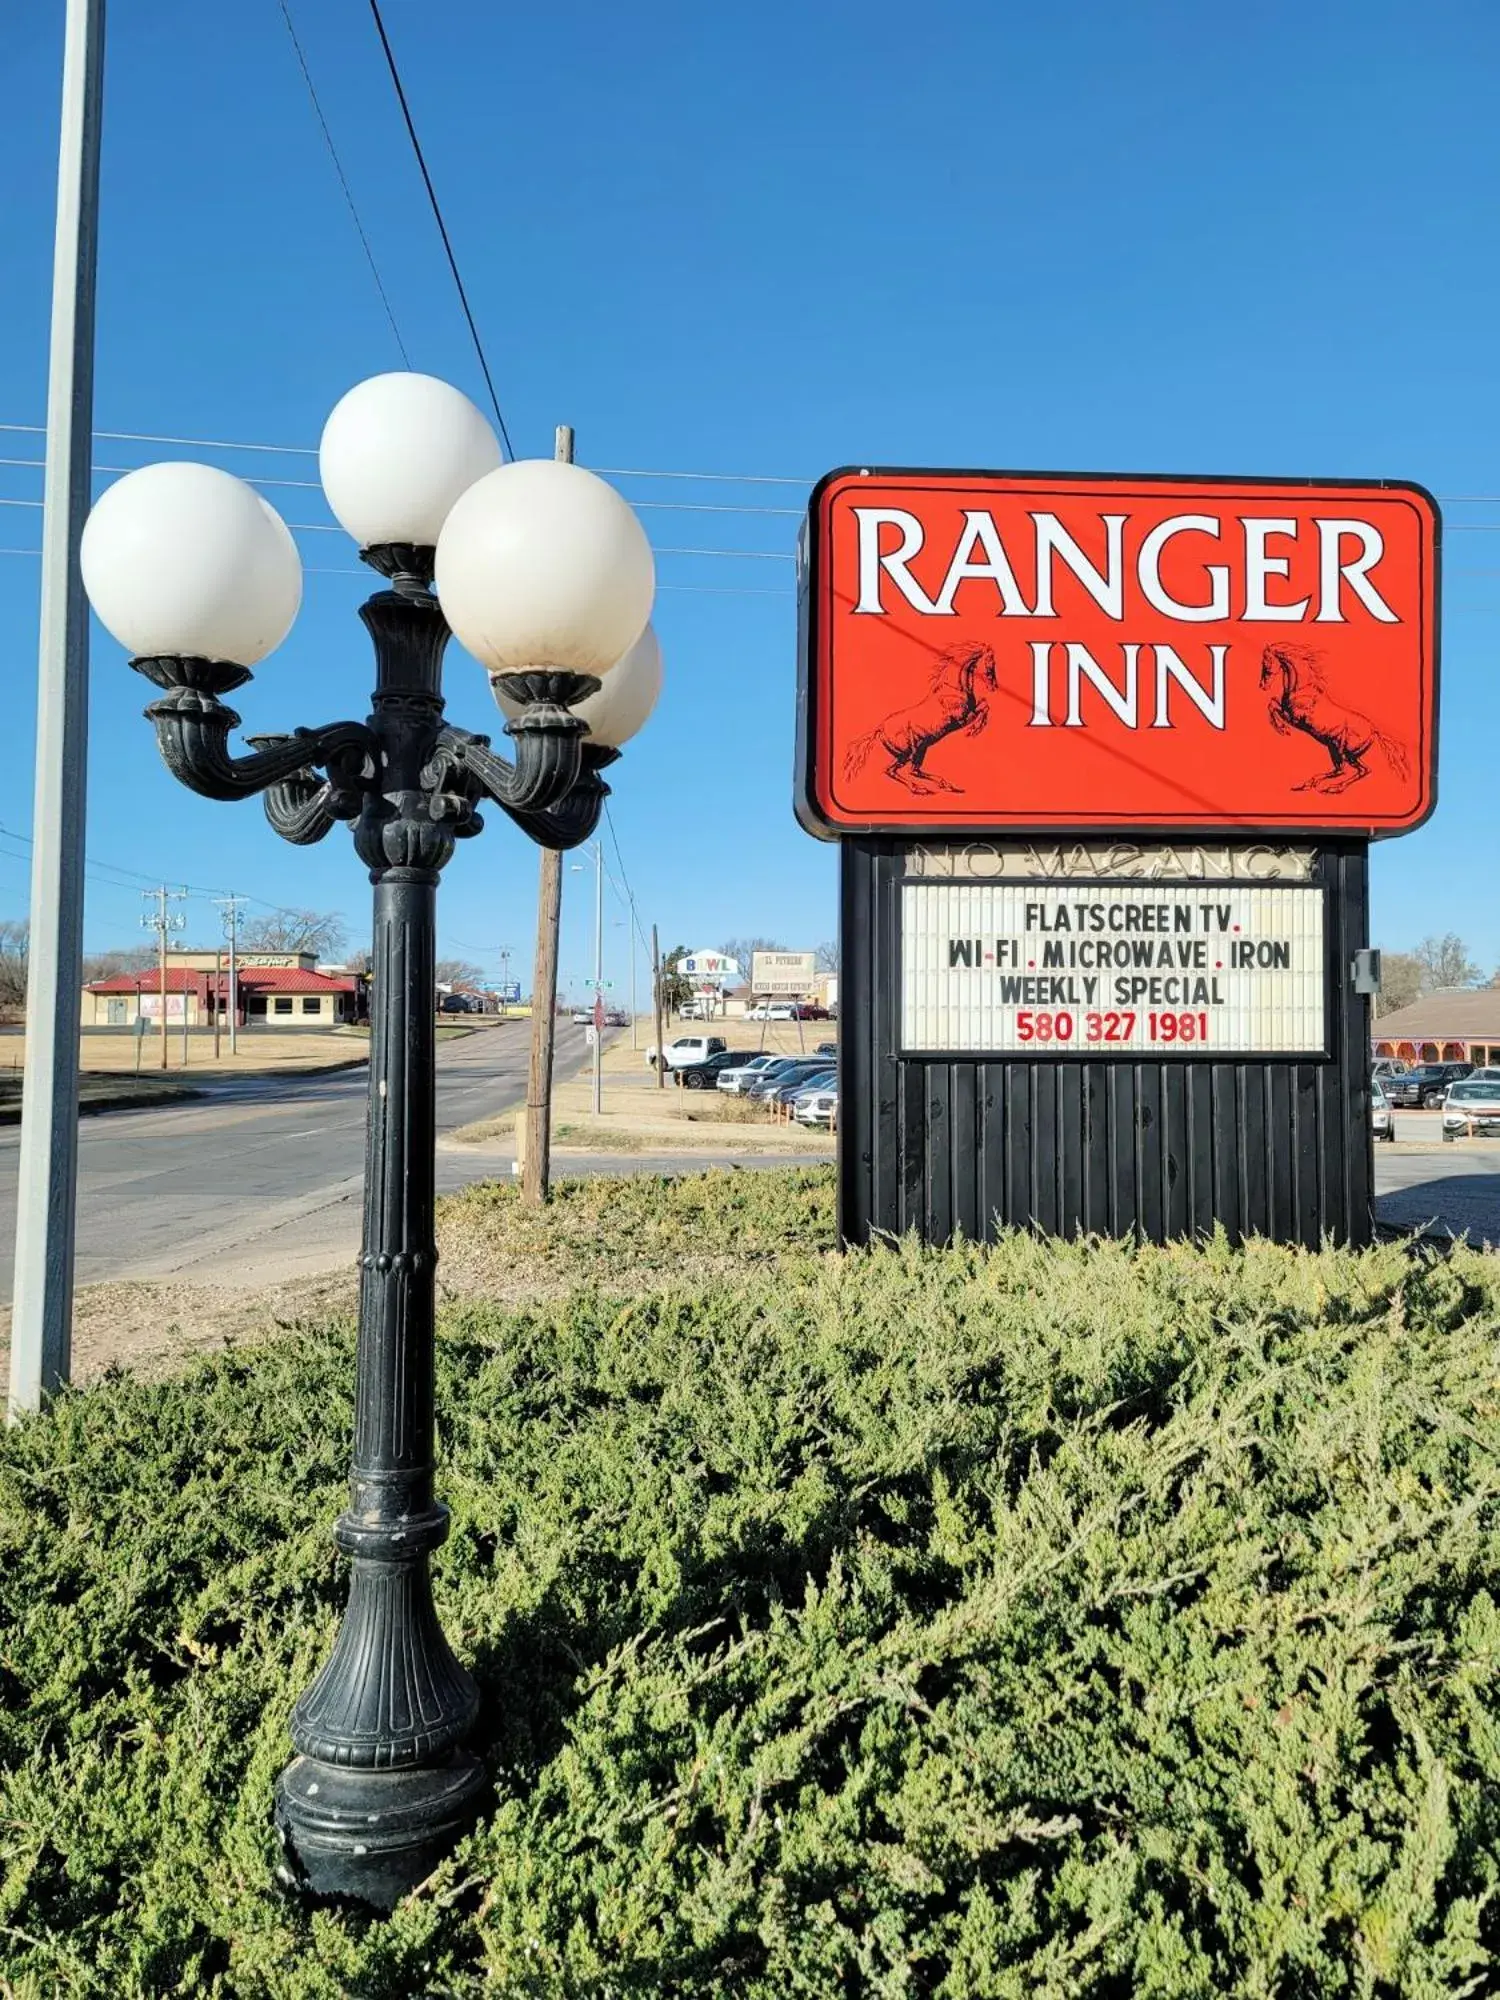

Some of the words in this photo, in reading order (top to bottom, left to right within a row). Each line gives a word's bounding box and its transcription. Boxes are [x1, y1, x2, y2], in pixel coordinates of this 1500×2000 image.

[849, 506, 1402, 624] RANGER
[1027, 641, 1231, 730] INN
[911, 842, 1004, 878] NO
[1024, 843, 1318, 880] VACANCY
[1199, 904, 1241, 933] TV.
[1231, 940, 1291, 969] IRON
[1000, 976, 1098, 1005] WEEKLY
[1114, 976, 1225, 1005] SPECIAL
[1016, 1012, 1073, 1041] 580
[1085, 1012, 1136, 1041] 327
[1149, 1012, 1207, 1041] 1981
